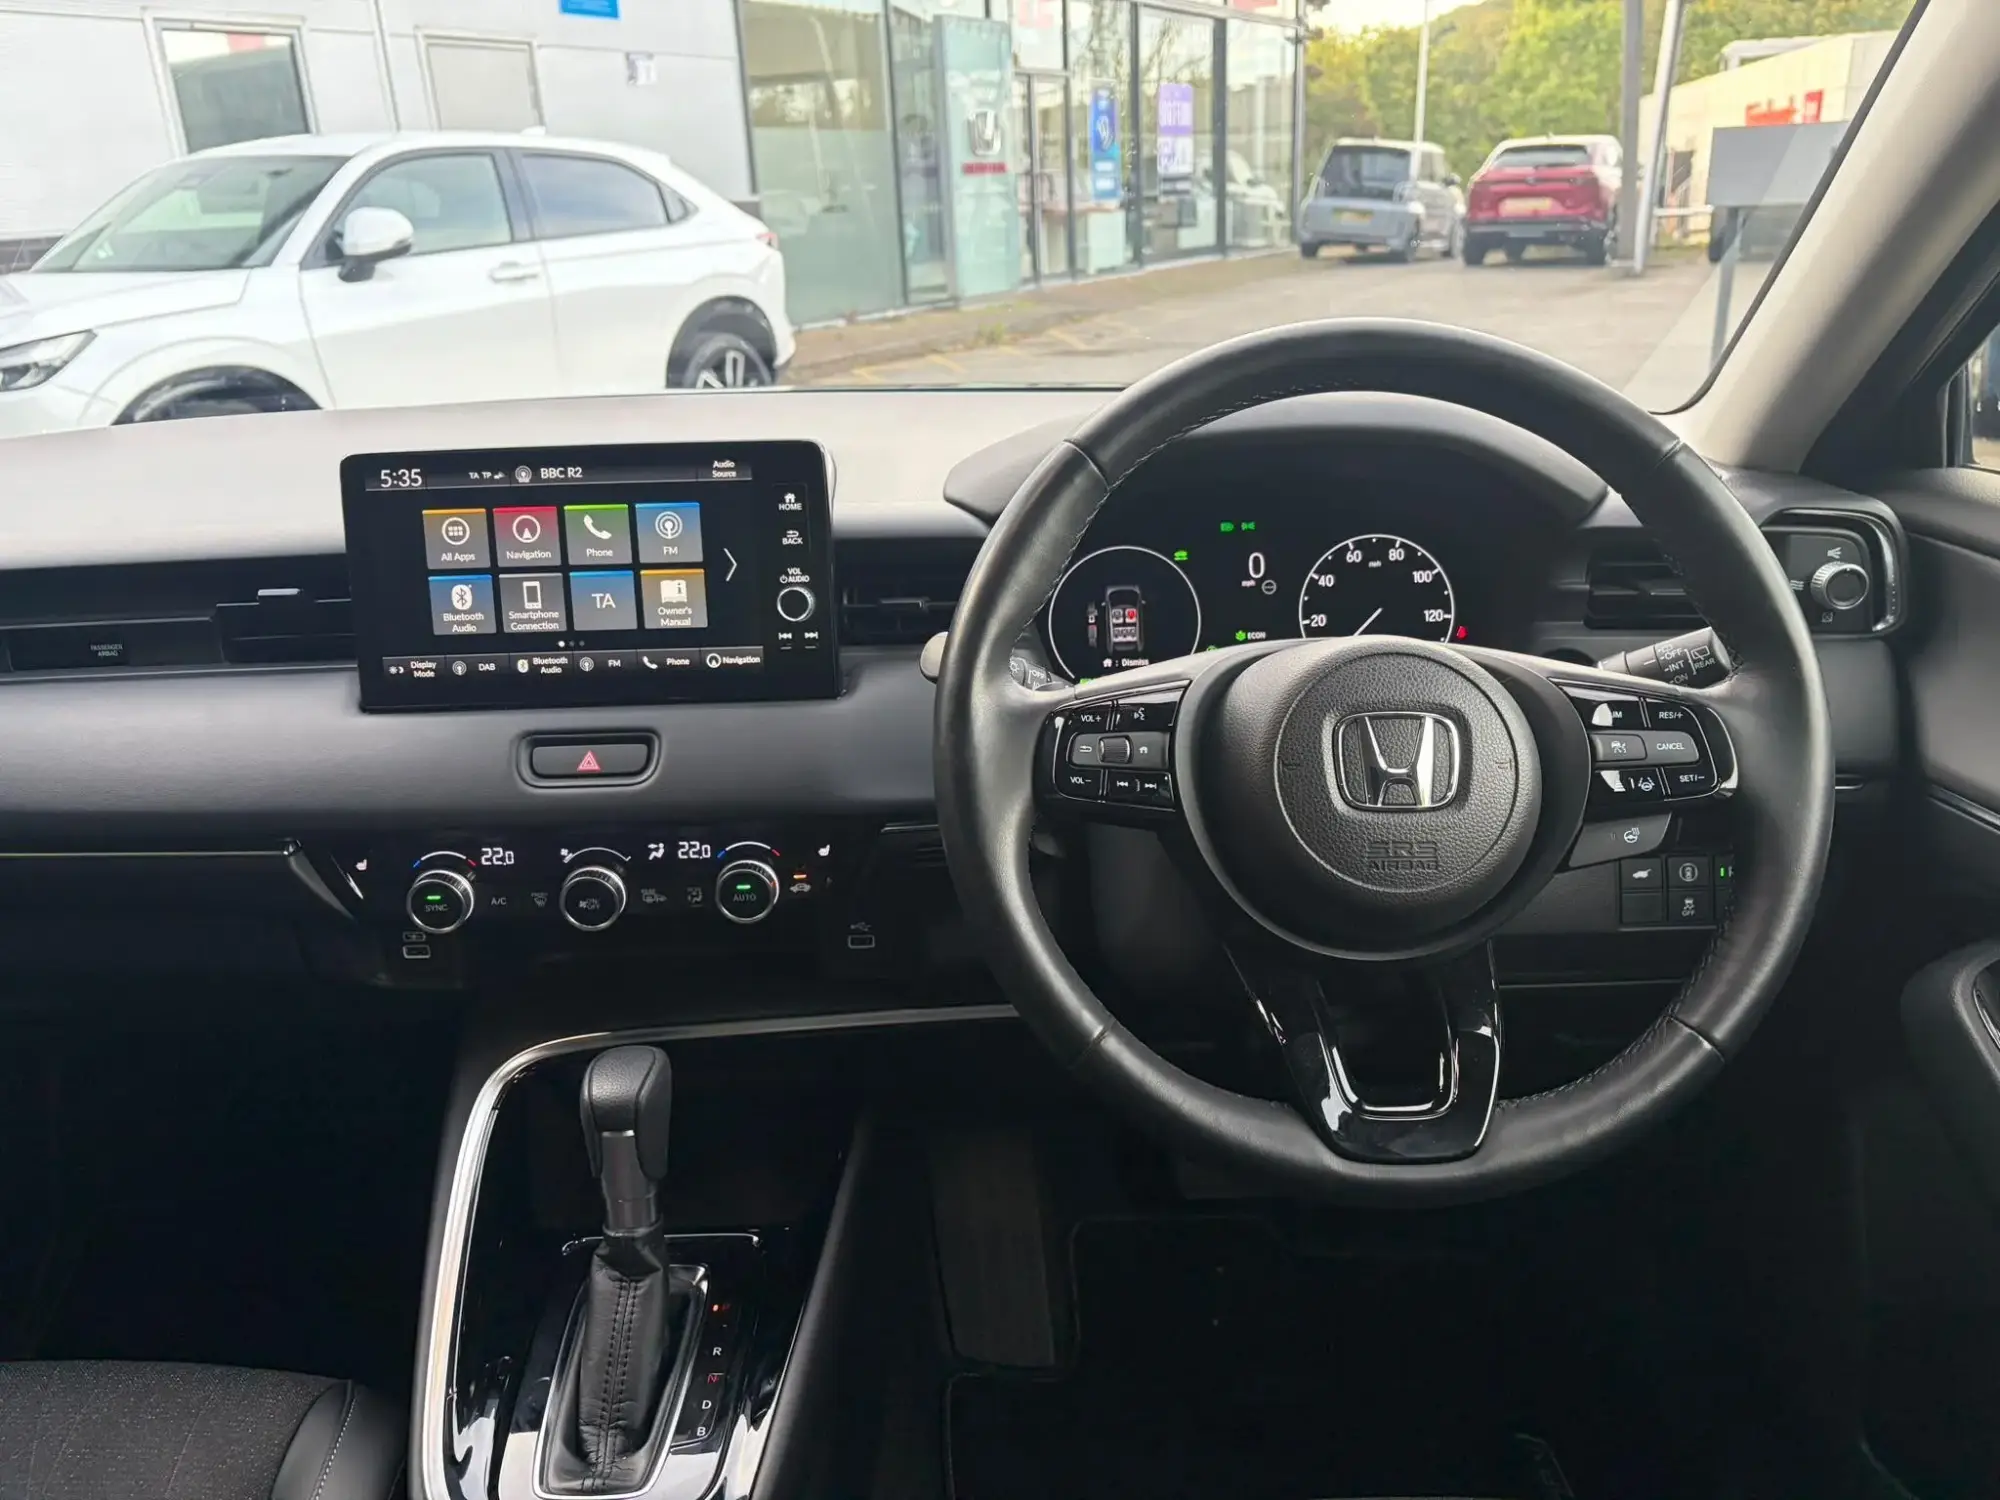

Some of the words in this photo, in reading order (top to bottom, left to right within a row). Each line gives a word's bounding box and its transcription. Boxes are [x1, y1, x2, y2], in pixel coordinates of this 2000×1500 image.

[712, 460, 735, 469] Audio
[380, 469, 422, 488] 5:35
[468, 471, 480, 480] TA
[482, 471, 492, 480] TP
[540, 468, 566, 480] BBC
[567, 467, 583, 478] R2
[712, 469, 737, 478] Source
[778, 503, 803, 511] HOME
[782, 537, 803, 545] BACK
[506, 549, 552, 560] Navigation
[586, 548, 614, 558] Phone
[663, 546, 678, 556] FM
[1346, 550, 1362, 562] 60
[1388, 548, 1405, 561] 80
[440, 552, 453, 562] All
[454, 552, 476, 564] Apps
[1248, 552, 1265, 579] 0
[787, 567, 802, 575] VOL
[788, 575, 810, 583] AUDIO
[1318, 574, 1335, 588] 40
[1412, 570, 1433, 584] 100
[592, 593, 616, 610] TA
[508, 610, 560, 621] Smartphone
[657, 606, 693, 616] Owner's
[1424, 609, 1444, 622] 120
[443, 612, 485, 622] Bluetooth
[660, 616, 692, 628] Manual
[1310, 614, 1327, 627] 20
[452, 622, 478, 634] Audio
[510, 620, 560, 632] Connection
[1247, 632, 1266, 640] ECON
[1664, 648, 1682, 660] OFF
[532, 656, 568, 666] Bluetooth
[608, 659, 622, 668] FM
[666, 657, 690, 666] Phone
[722, 654, 761, 665] Navigation
[1694, 658, 1716, 670] REAR
[410, 660, 437, 670] Display
[478, 662, 496, 672] DAB
[540, 665, 562, 675] Audio
[1668, 660, 1685, 672] INT
[414, 669, 436, 679] Mode
[1674, 673, 1689, 684] ON
[1656, 742, 1686, 750] CANCEL
[677, 841, 711, 860] 22.0
[480, 847, 515, 866] 22.0
[490, 897, 507, 906] A/C
[733, 893, 757, 902] AUTO
[425, 904, 449, 912] SYNC
[712, 1346, 722, 1356] R
[702, 1400, 712, 1410] D
[696, 1426, 706, 1436] B
